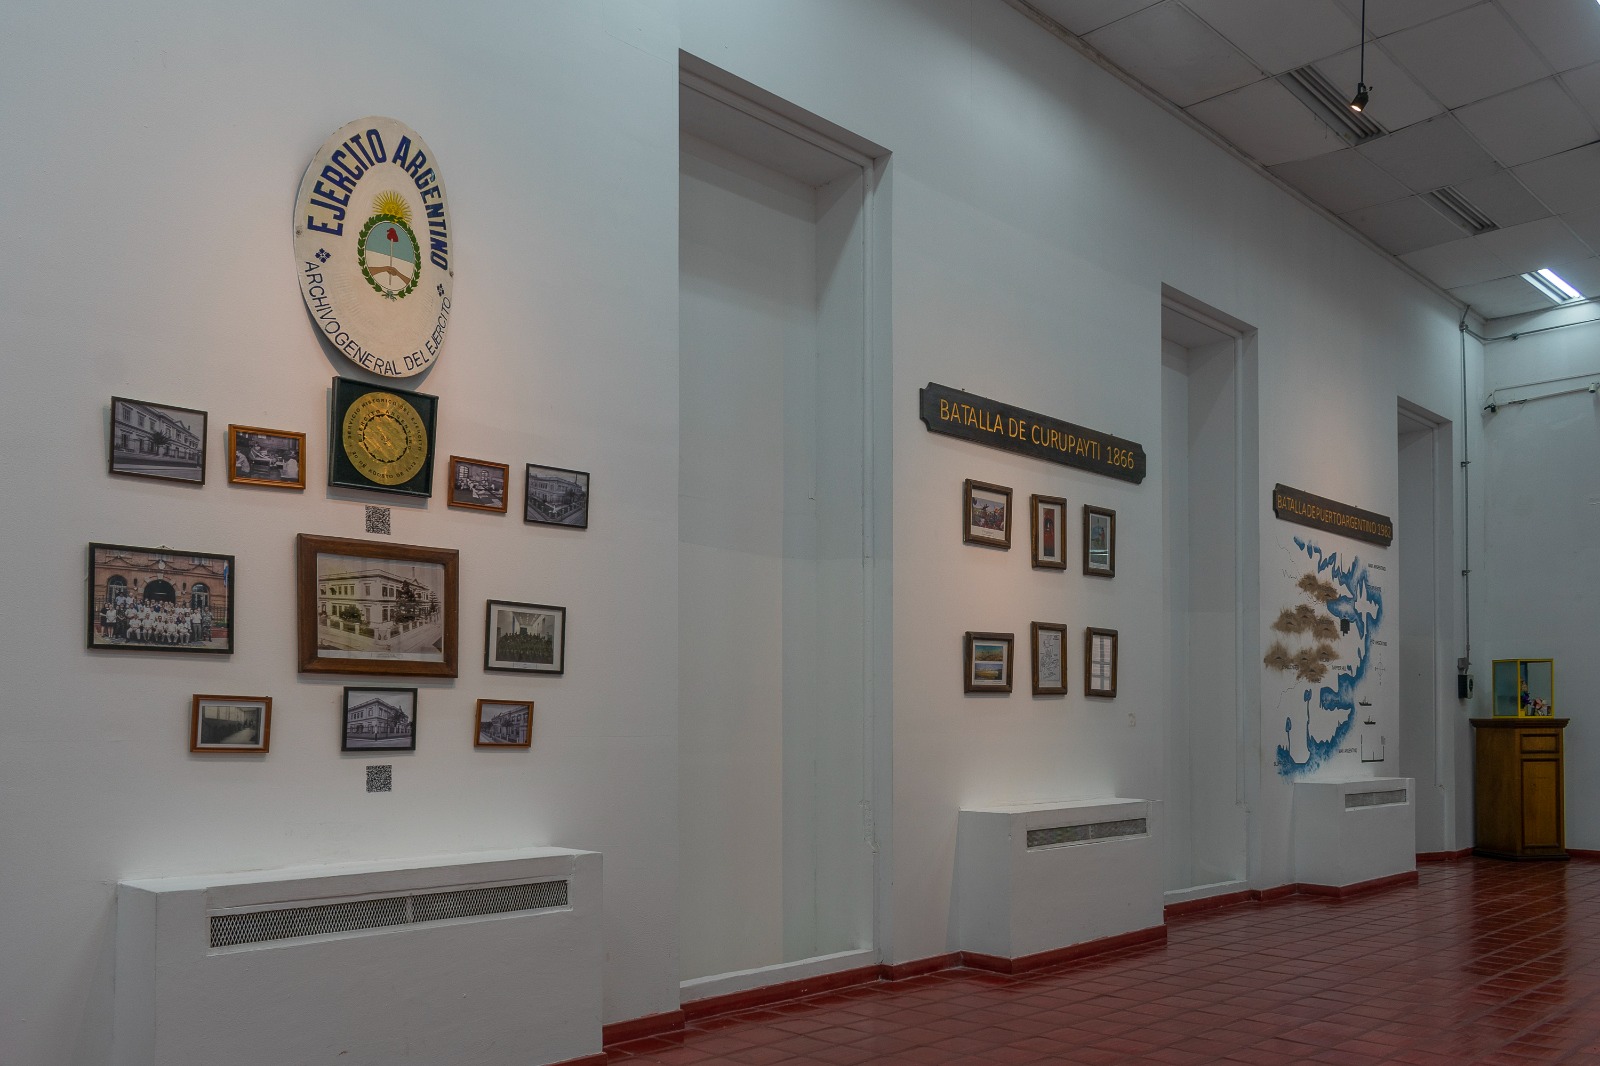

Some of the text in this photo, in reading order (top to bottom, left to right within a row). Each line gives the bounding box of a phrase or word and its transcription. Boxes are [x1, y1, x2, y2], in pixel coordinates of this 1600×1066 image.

[307, 128, 449, 271] EJERCITO ARGENTINO
[305, 261, 452, 376] ARCHIVO GENERAL DEL EJERCITO
[939, 398, 1135, 470] BATALLA DE CURUPAYTI 1866
